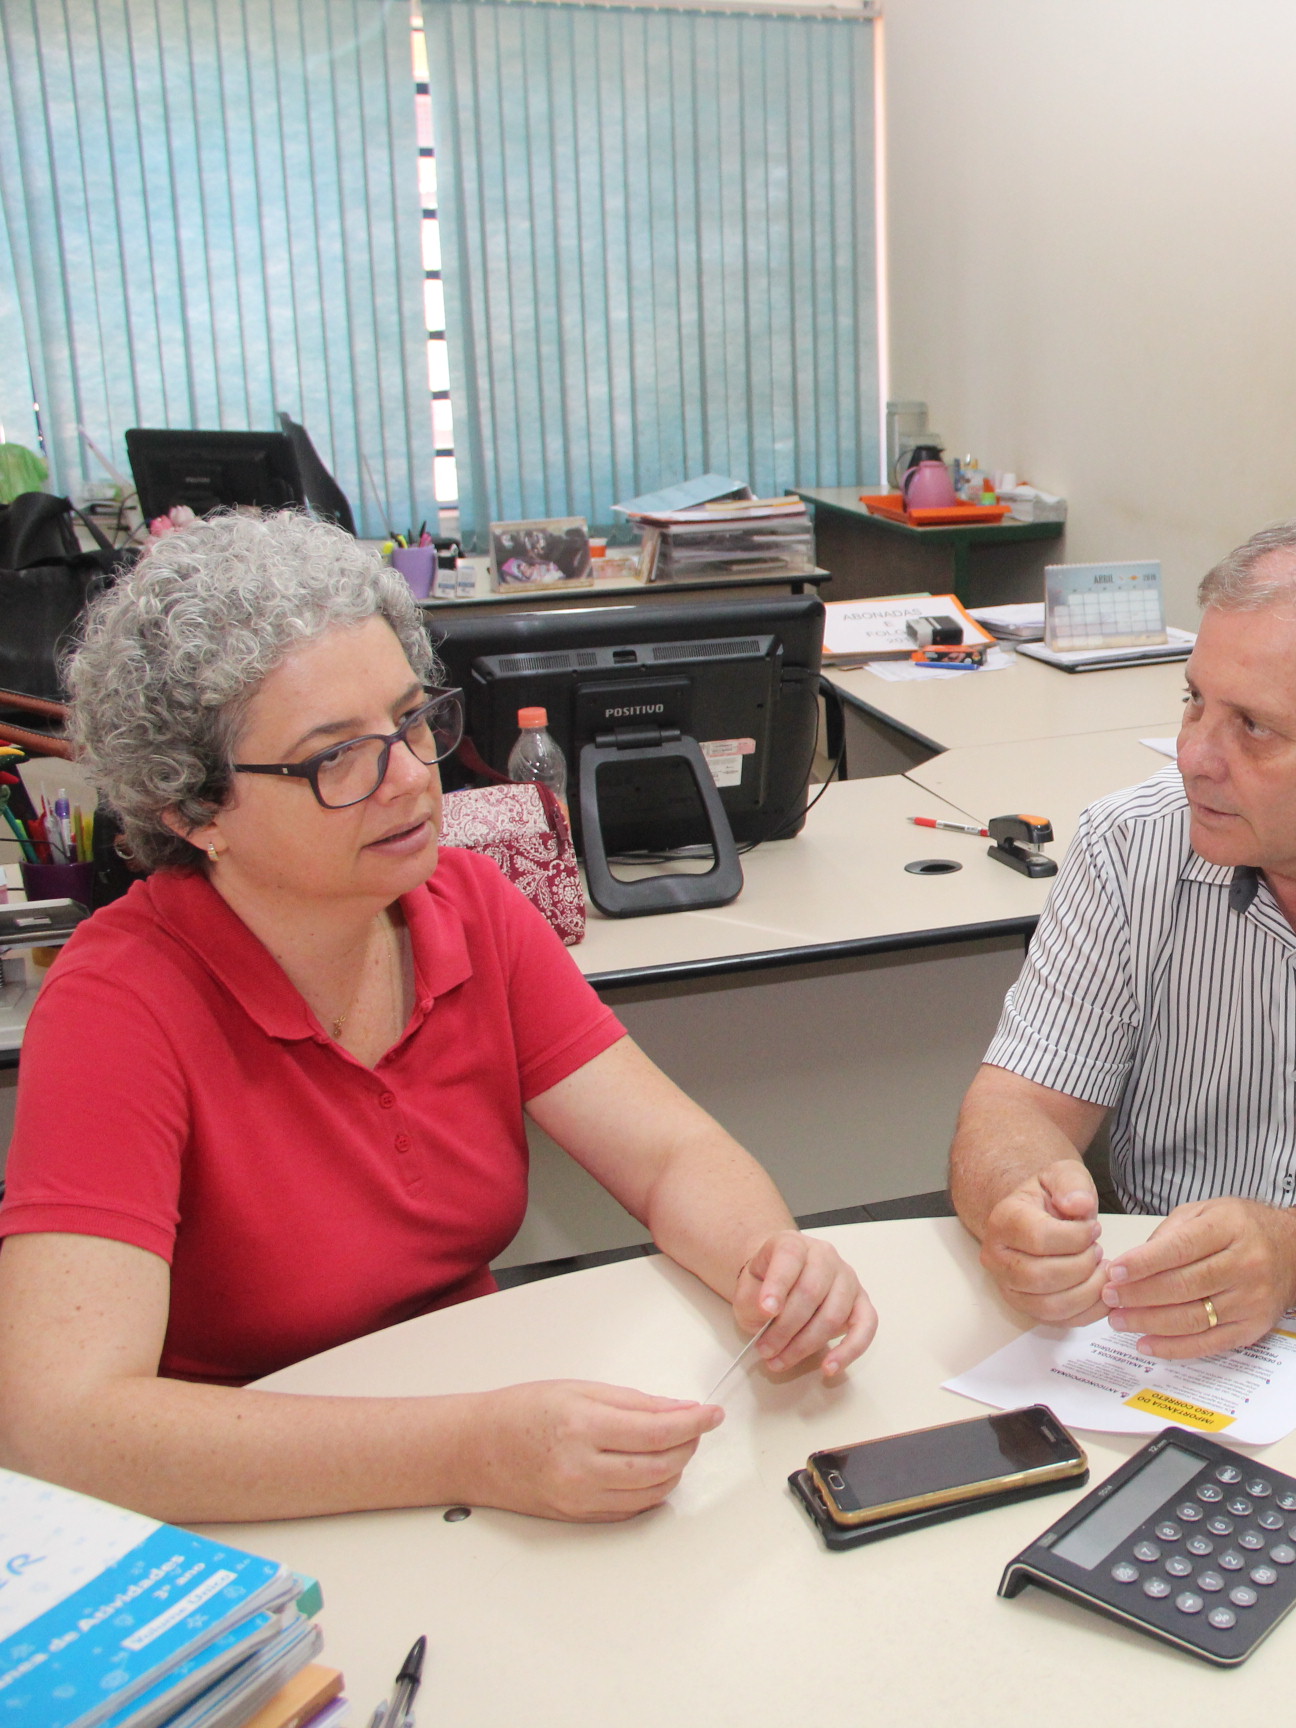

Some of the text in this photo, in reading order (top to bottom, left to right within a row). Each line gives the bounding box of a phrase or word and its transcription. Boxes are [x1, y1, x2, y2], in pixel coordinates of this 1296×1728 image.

[1093, 574, 1114, 584] ABRIL
[843, 609, 922, 621] ABONADAS
[605, 703, 664, 718] POSITIVO
[1098, 1351, 1142, 1369] ANALGÉSICOS
[1050, 1368, 1118, 1393] ANTICONCEPCIONAIS
[1137, 1395, 1215, 1425] IMPORTÂNCIA DO
[1151, 1392, 1215, 1417] USO CORRETO
[1141, 1547, 1151, 1555] 7
[1194, 1542, 1205, 1550] 5
[1226, 1556, 1237, 1565] 2
[1246, 1536, 1257, 1544] 3
[176, 1562, 206, 1586] ano
[48, 1631, 79, 1652] de
[77, 1554, 185, 1632] Atividades
[1237, 1592, 1249, 1600] 0
